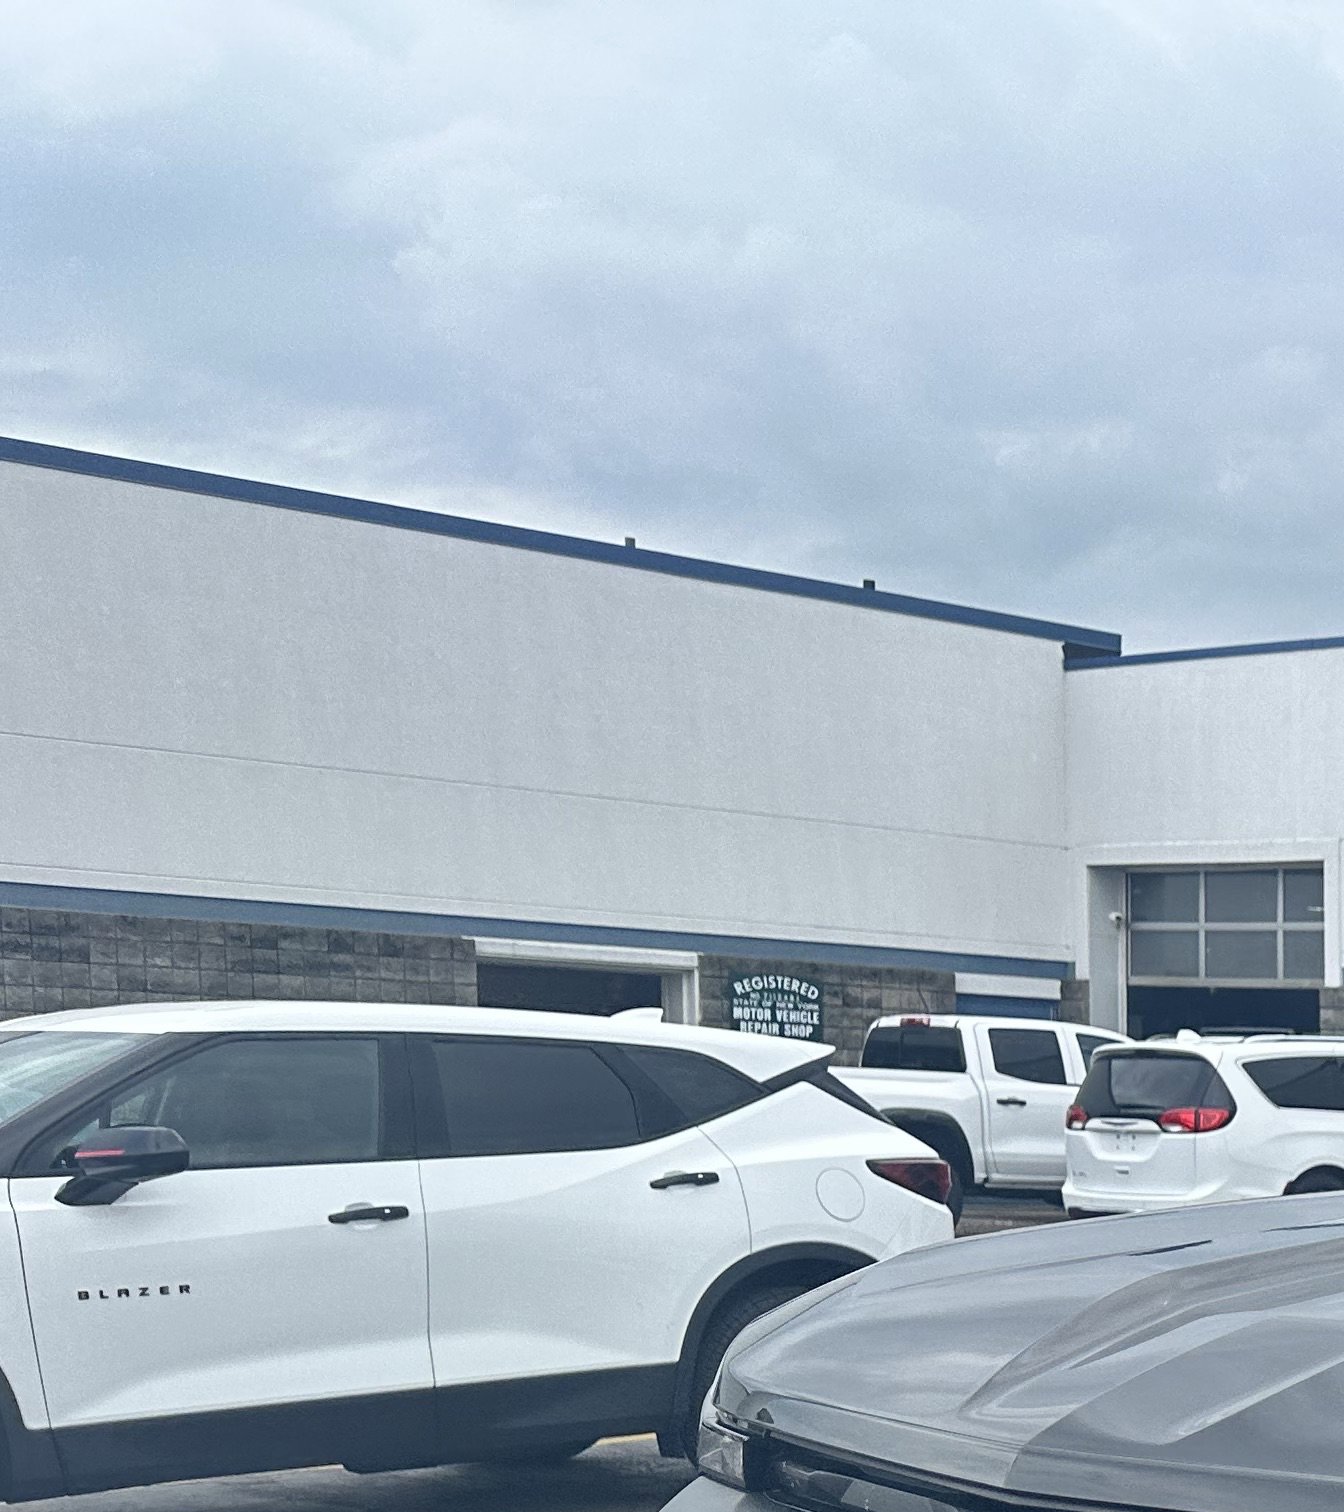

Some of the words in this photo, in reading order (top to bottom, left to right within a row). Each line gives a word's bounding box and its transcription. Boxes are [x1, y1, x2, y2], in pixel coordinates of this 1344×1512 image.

[733, 975, 819, 1000] REGISTERED
[733, 1006, 771, 1021] MOTOR
[775, 1009, 820, 1025] VEHICLE
[740, 1021, 780, 1035] REPAIR
[784, 1024, 813, 1038] SHOP
[77, 1284, 191, 1300] BLAZER
